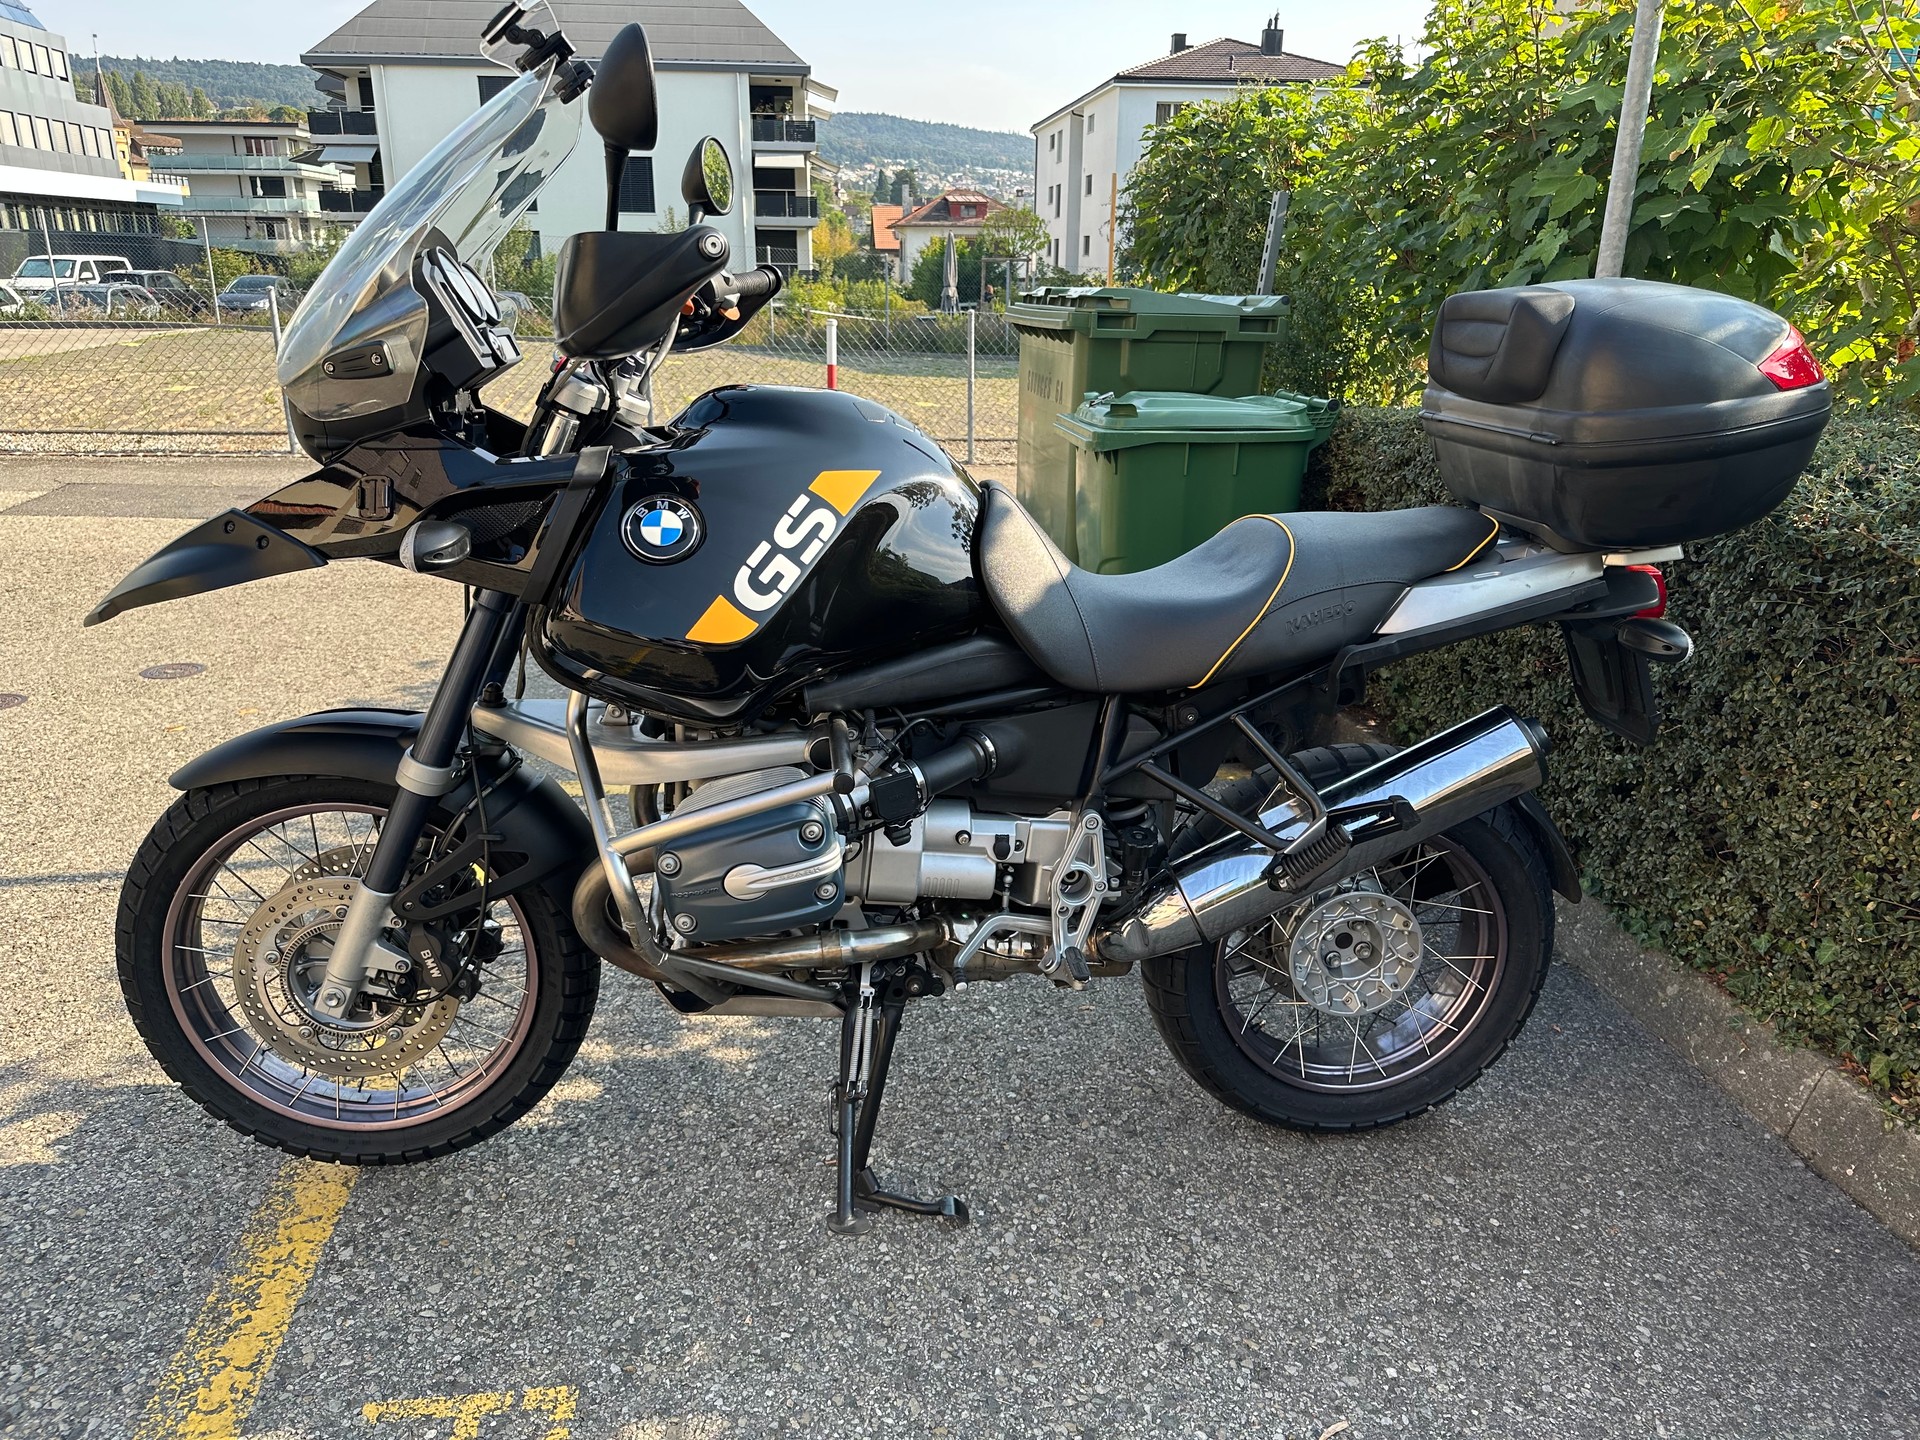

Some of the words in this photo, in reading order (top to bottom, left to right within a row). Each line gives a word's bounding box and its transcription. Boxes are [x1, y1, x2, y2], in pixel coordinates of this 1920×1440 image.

[635, 500, 690, 520] BMW
[733, 493, 837, 612] GS
[1285, 600, 1358, 637] KAHEDO
[420, 949, 442, 978] BMW
